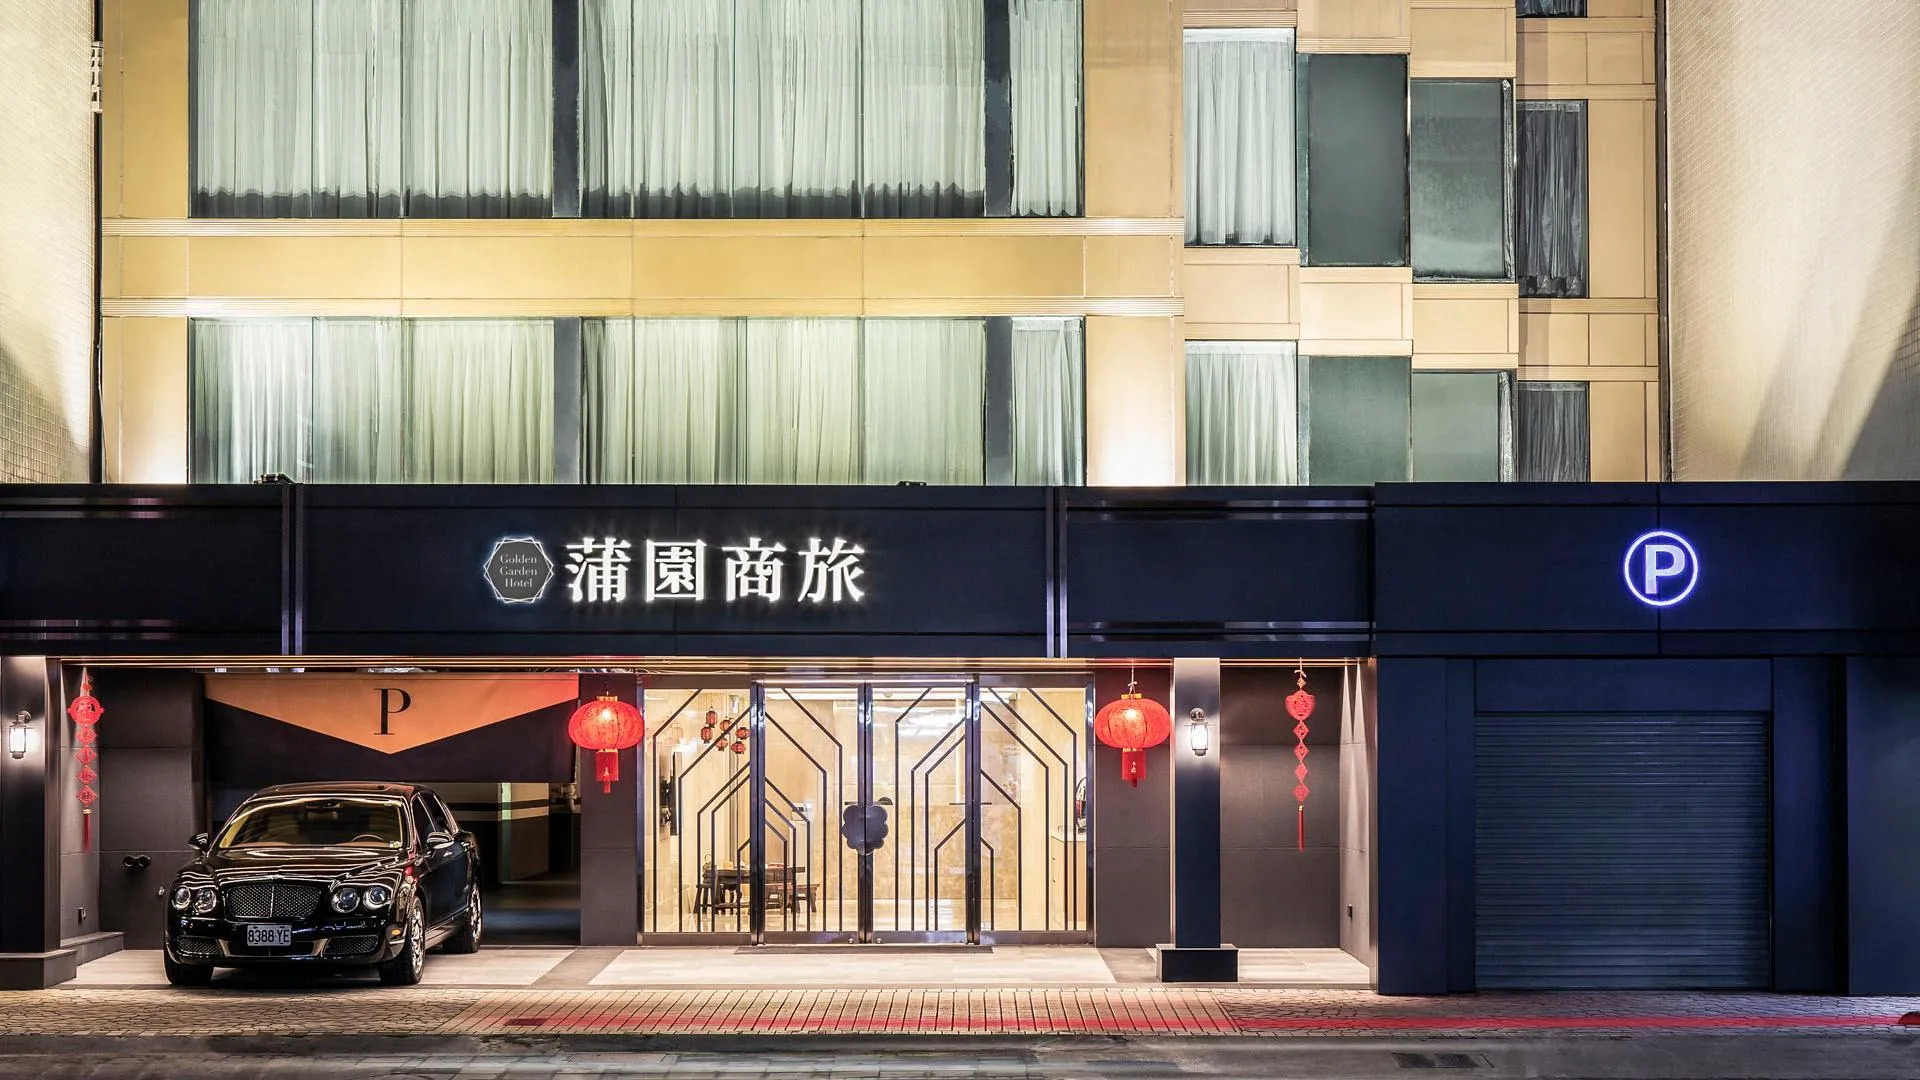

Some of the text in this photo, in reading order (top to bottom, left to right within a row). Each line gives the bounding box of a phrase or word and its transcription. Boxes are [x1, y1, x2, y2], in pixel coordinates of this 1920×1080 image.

[500, 554, 537, 564] Golden
[500, 566, 538, 576] Garden
[565, 537, 865, 602] 蒲園商旅
[1645, 544, 1686, 594] P
[505, 578, 533, 588] Hotel
[373, 688, 412, 736] P
